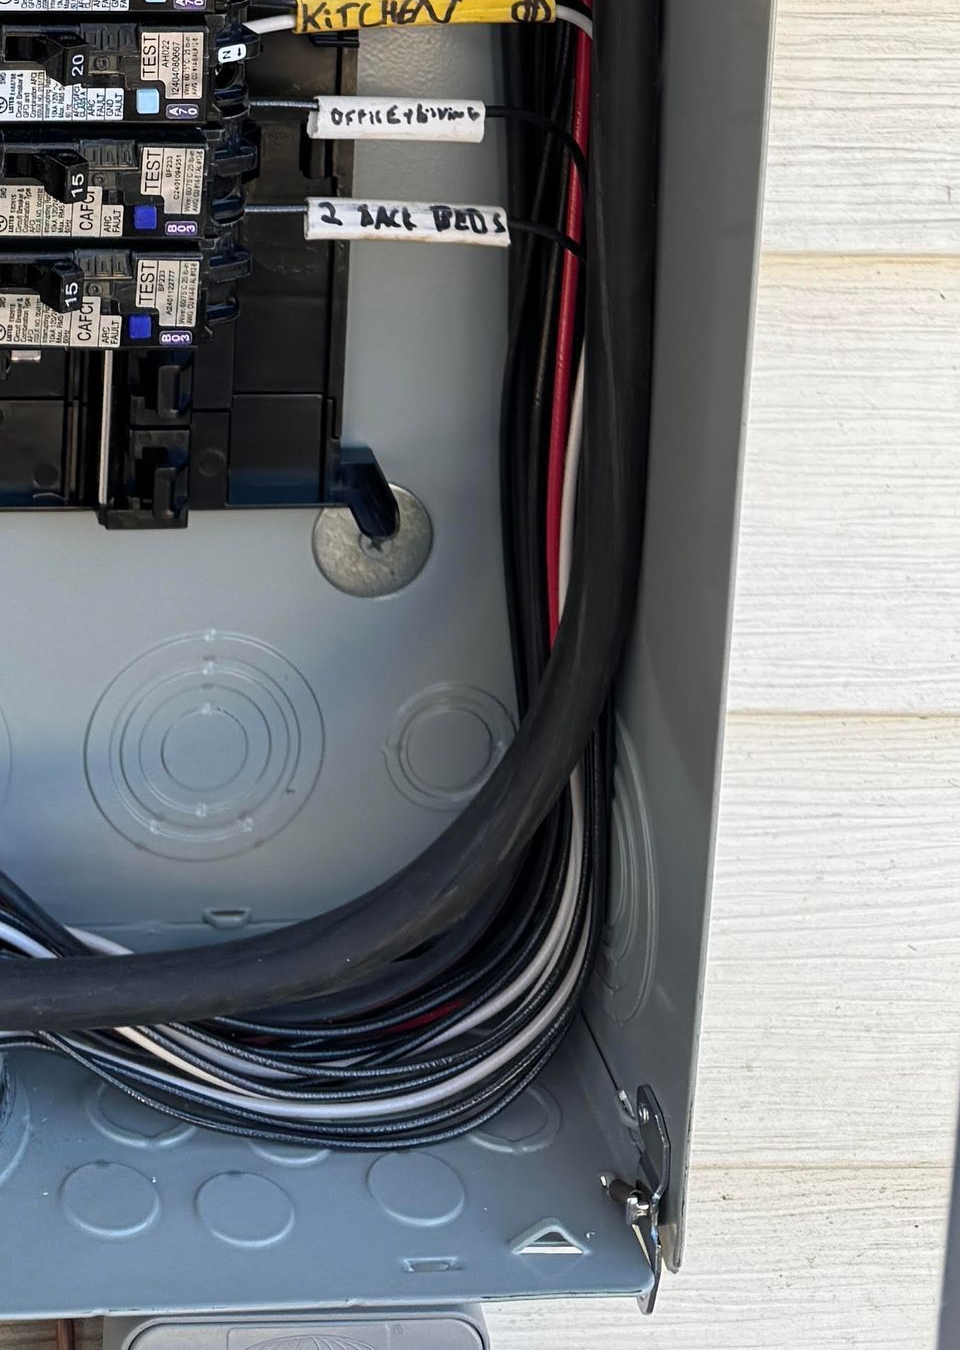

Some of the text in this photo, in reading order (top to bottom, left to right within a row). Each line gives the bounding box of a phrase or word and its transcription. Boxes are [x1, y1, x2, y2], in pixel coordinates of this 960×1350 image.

[71, 53, 85, 77] 20
[141, 35, 157, 78] TEST
[143, 149, 161, 192] TEST
[70, 172, 84, 198] 15
[320, 202, 343, 226] 2
[65, 282, 78, 307] 15
[139, 262, 155, 304] TEST
